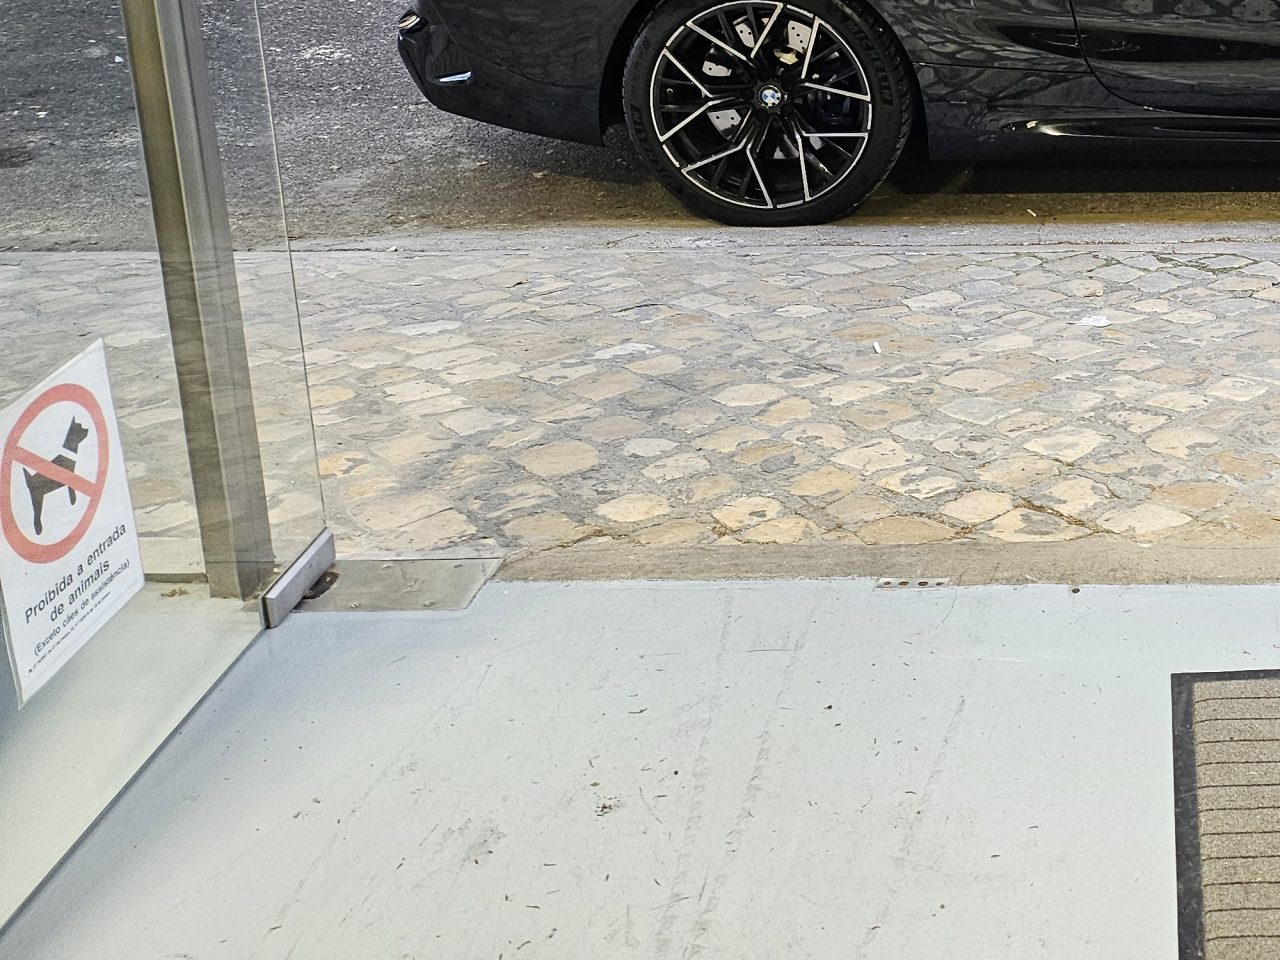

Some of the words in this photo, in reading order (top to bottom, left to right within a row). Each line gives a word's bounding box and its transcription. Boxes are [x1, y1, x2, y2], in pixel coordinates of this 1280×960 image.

[25, 574, 74, 624] Proibida
[77, 566, 84, 577] a
[87, 524, 127, 566] entrada
[51, 604, 65, 621] de
[69, 559, 110, 605] animais
[34, 626, 61, 656] (Exceto
[81, 598, 90, 610] de
